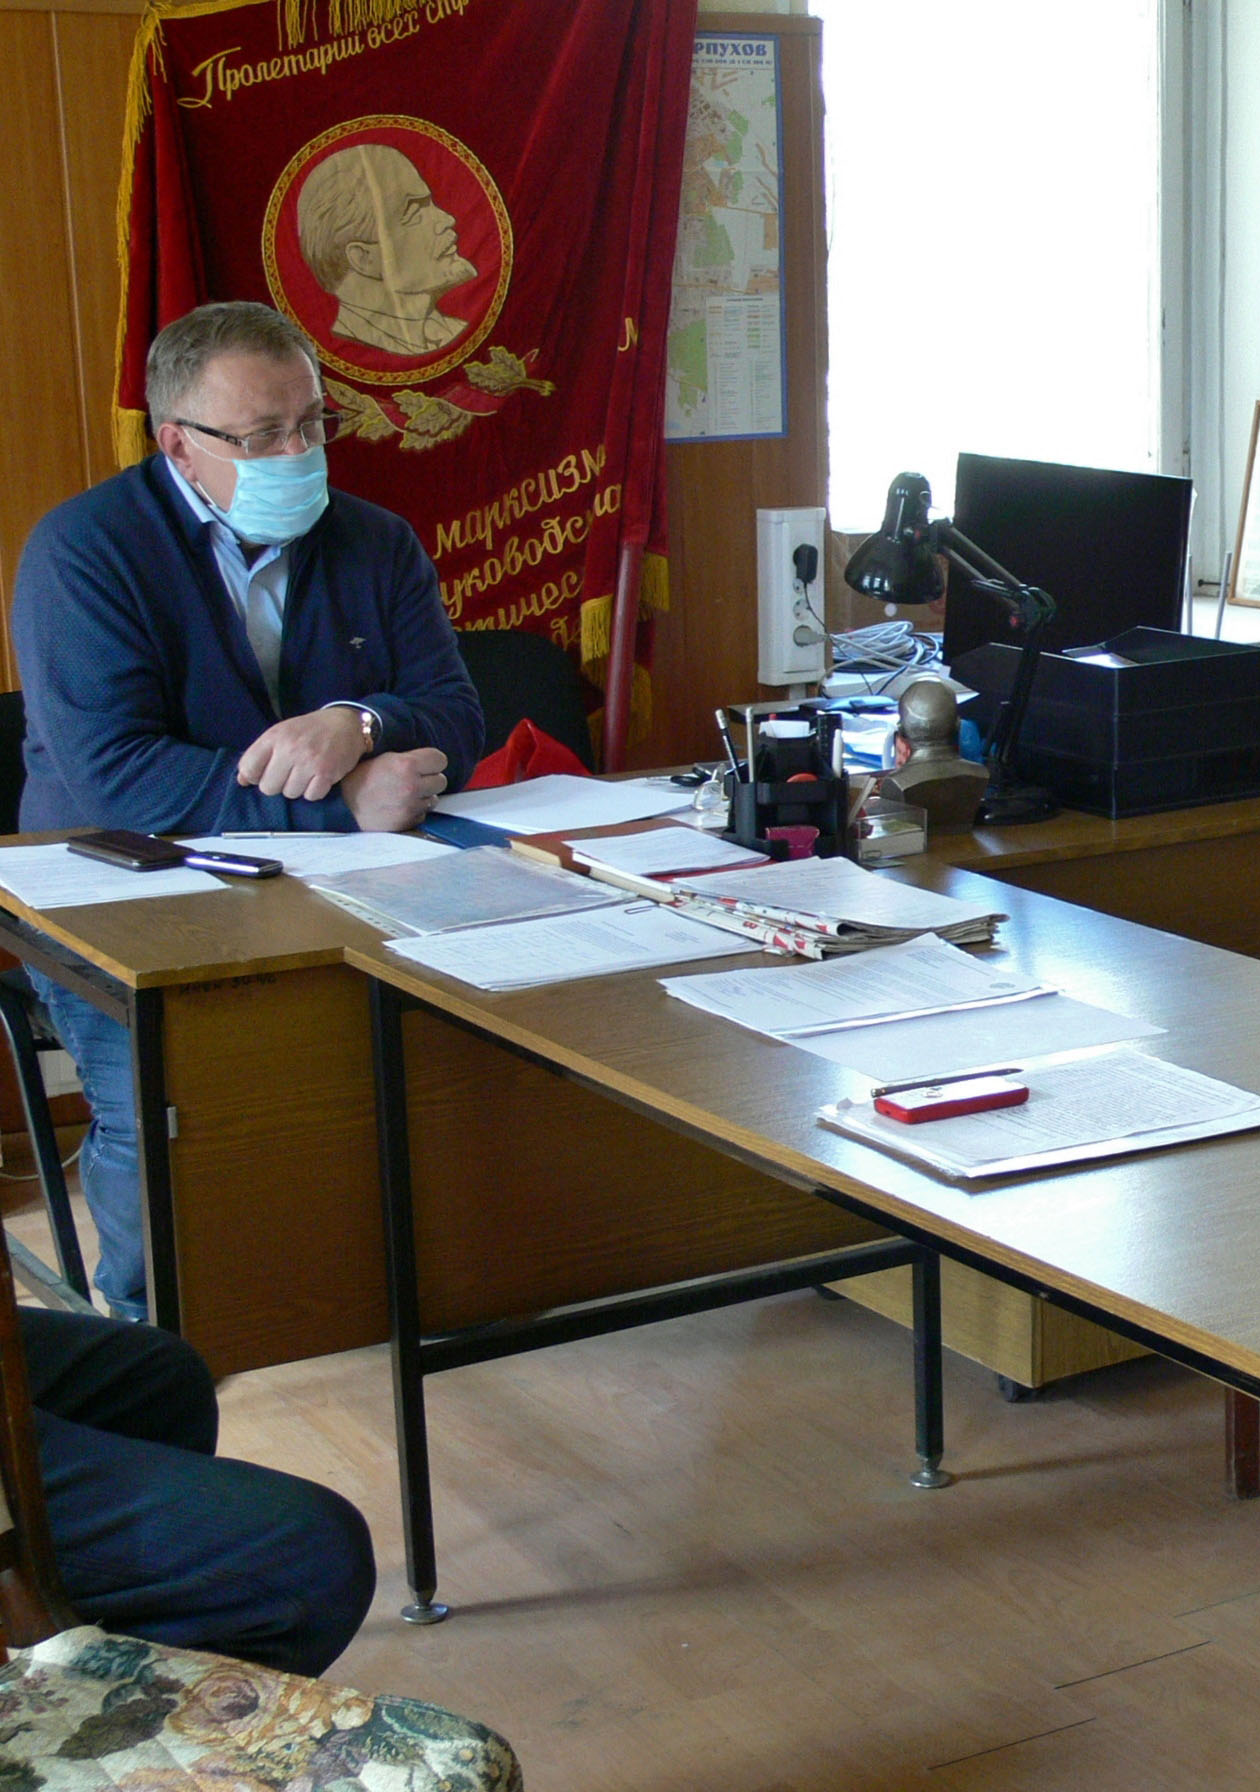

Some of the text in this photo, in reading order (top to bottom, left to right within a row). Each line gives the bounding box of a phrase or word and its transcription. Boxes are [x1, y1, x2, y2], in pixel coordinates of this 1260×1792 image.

[177, 36, 364, 108] Пролетарии
[367, 10, 420, 49] всех
[695, 42, 768, 57] РПУХОВ
